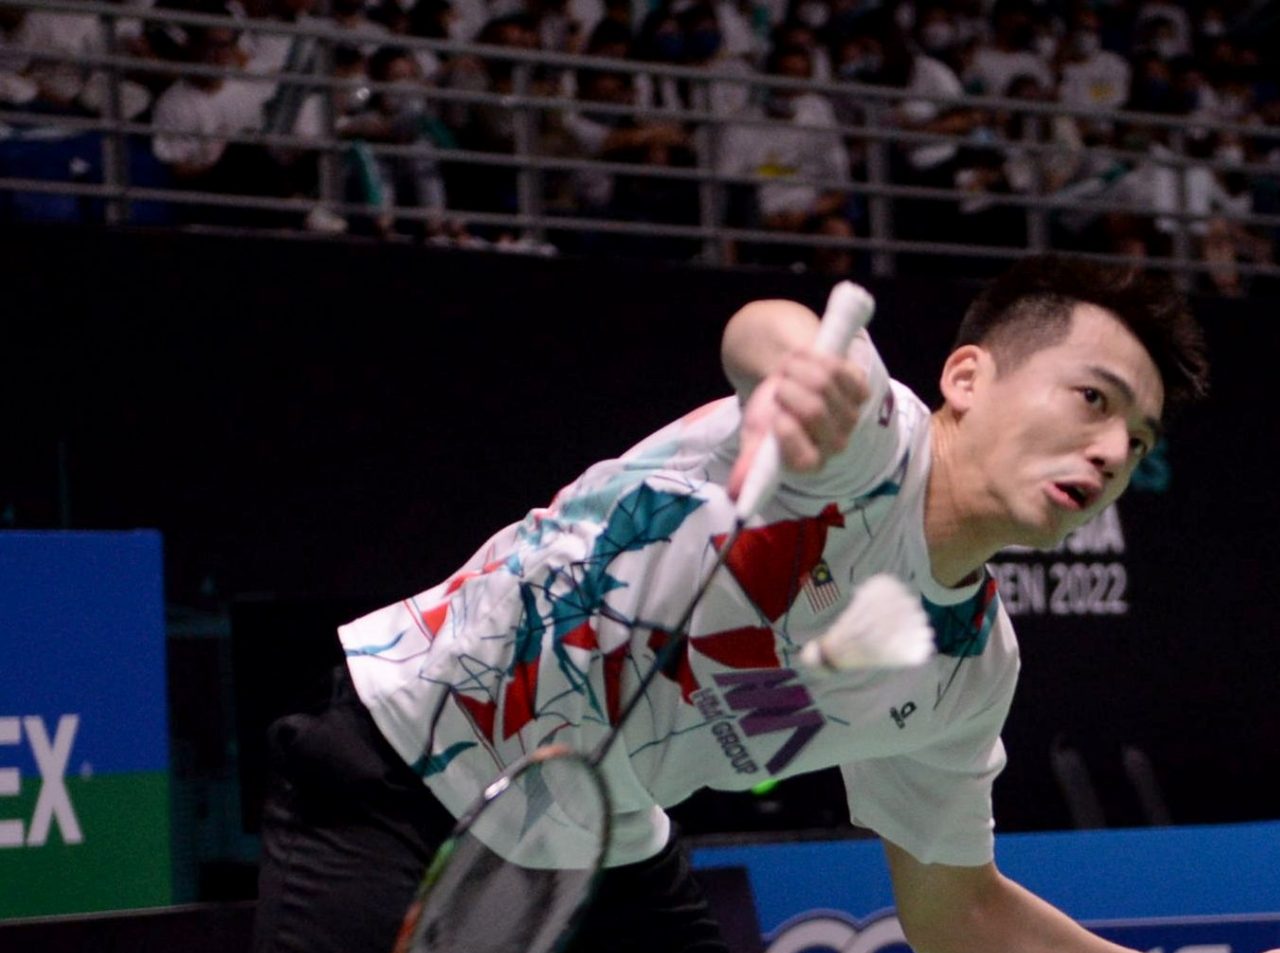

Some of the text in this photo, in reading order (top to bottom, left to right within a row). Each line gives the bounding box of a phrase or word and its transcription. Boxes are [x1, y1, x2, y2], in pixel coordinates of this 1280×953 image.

[989, 562, 1127, 615] EN 2022
[712, 721, 759, 774] GROUP
[0, 713, 84, 847] EX
